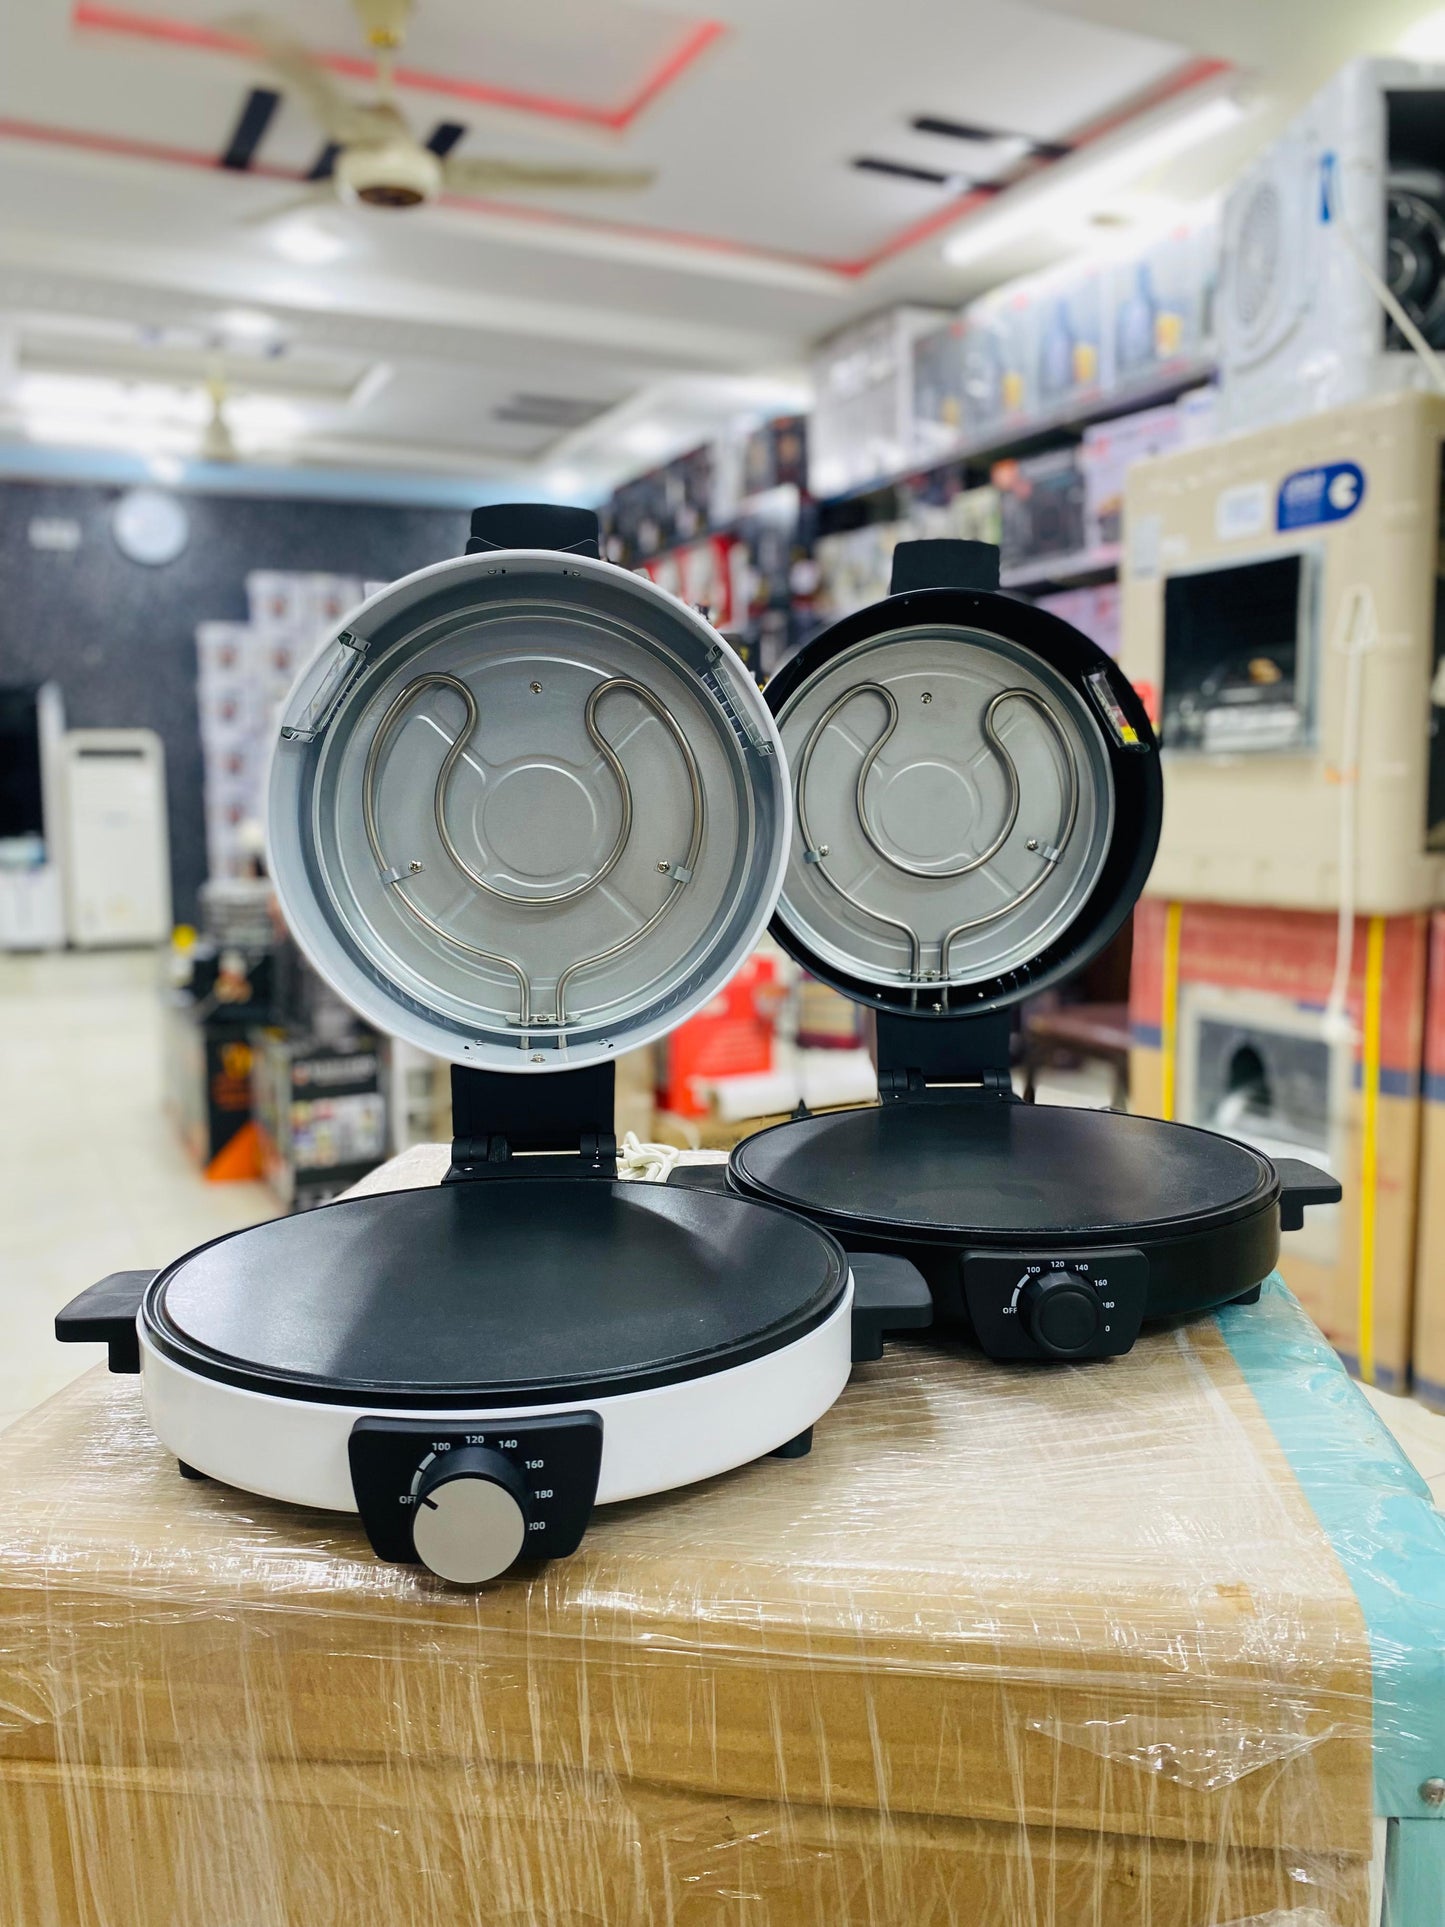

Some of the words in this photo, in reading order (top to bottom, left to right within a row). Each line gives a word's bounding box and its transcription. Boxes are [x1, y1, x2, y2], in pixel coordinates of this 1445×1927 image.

[1050, 1260, 1065, 1268] 120
[1074, 1264, 1089, 1272] 140
[1026, 1266, 1041, 1274] 100
[1094, 1279, 1108, 1287] 160
[465, 1435, 485, 1444] 120
[499, 1439, 518, 1449] 140
[432, 1442, 451, 1451] 100
[525, 1459, 544, 1469] 160
[534, 1489, 554, 1499] 180
